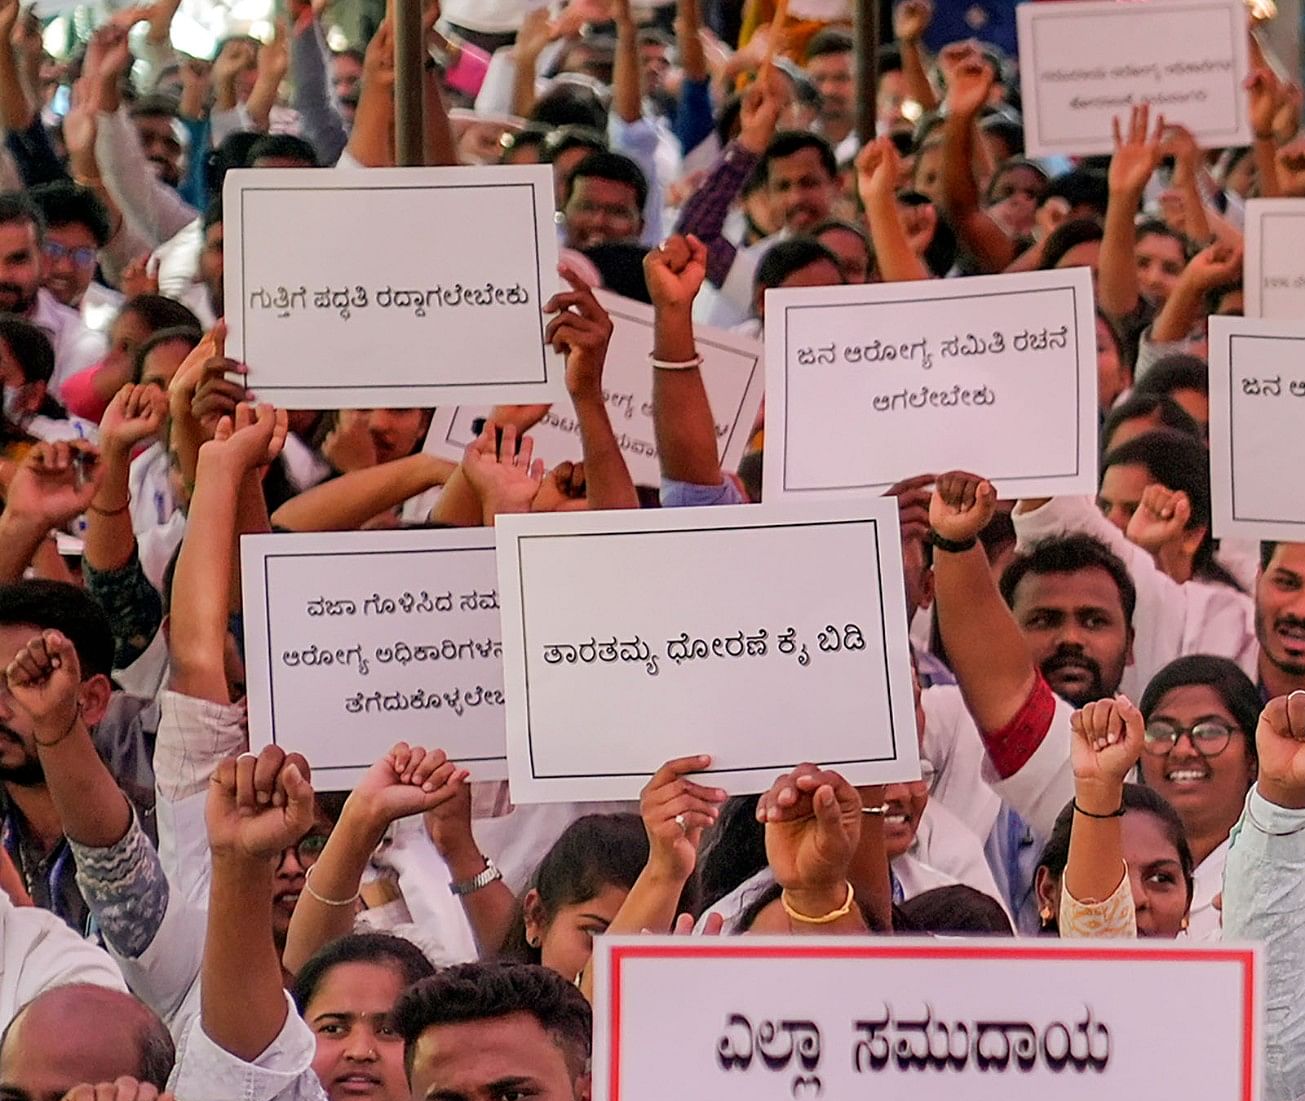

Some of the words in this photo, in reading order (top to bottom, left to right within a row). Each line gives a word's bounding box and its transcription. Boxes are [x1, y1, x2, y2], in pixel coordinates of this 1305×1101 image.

[796, 342, 837, 366] ಜನ
[843, 337, 933, 370] ಆರೋಗ್ಯ
[940, 331, 1006, 357] ಸಮಿತಿ
[1013, 325, 1069, 352] ರಚನೆ
[872, 384, 996, 412] ಆಗಲೇಬೇಕು
[1241, 375, 1282, 397] ಜನ
[307, 596, 357, 617] ವಜಾ
[363, 590, 453, 615] ಗೊಳಿಸಿದ
[282, 643, 370, 676] ಆರೋಗ್ಯ
[543, 635, 660, 676] ತಾರತಮ್ಯ
[666, 628, 769, 665] ಧೋರಣೆ
[777, 627, 811, 667] ಕೈ
[817, 623, 866, 652] ಬಿಡಿ
[717, 1013, 822, 1095] ಎಲ್ಲಾ
[854, 1009, 1110, 1074] ಸಮುದಾಯ
